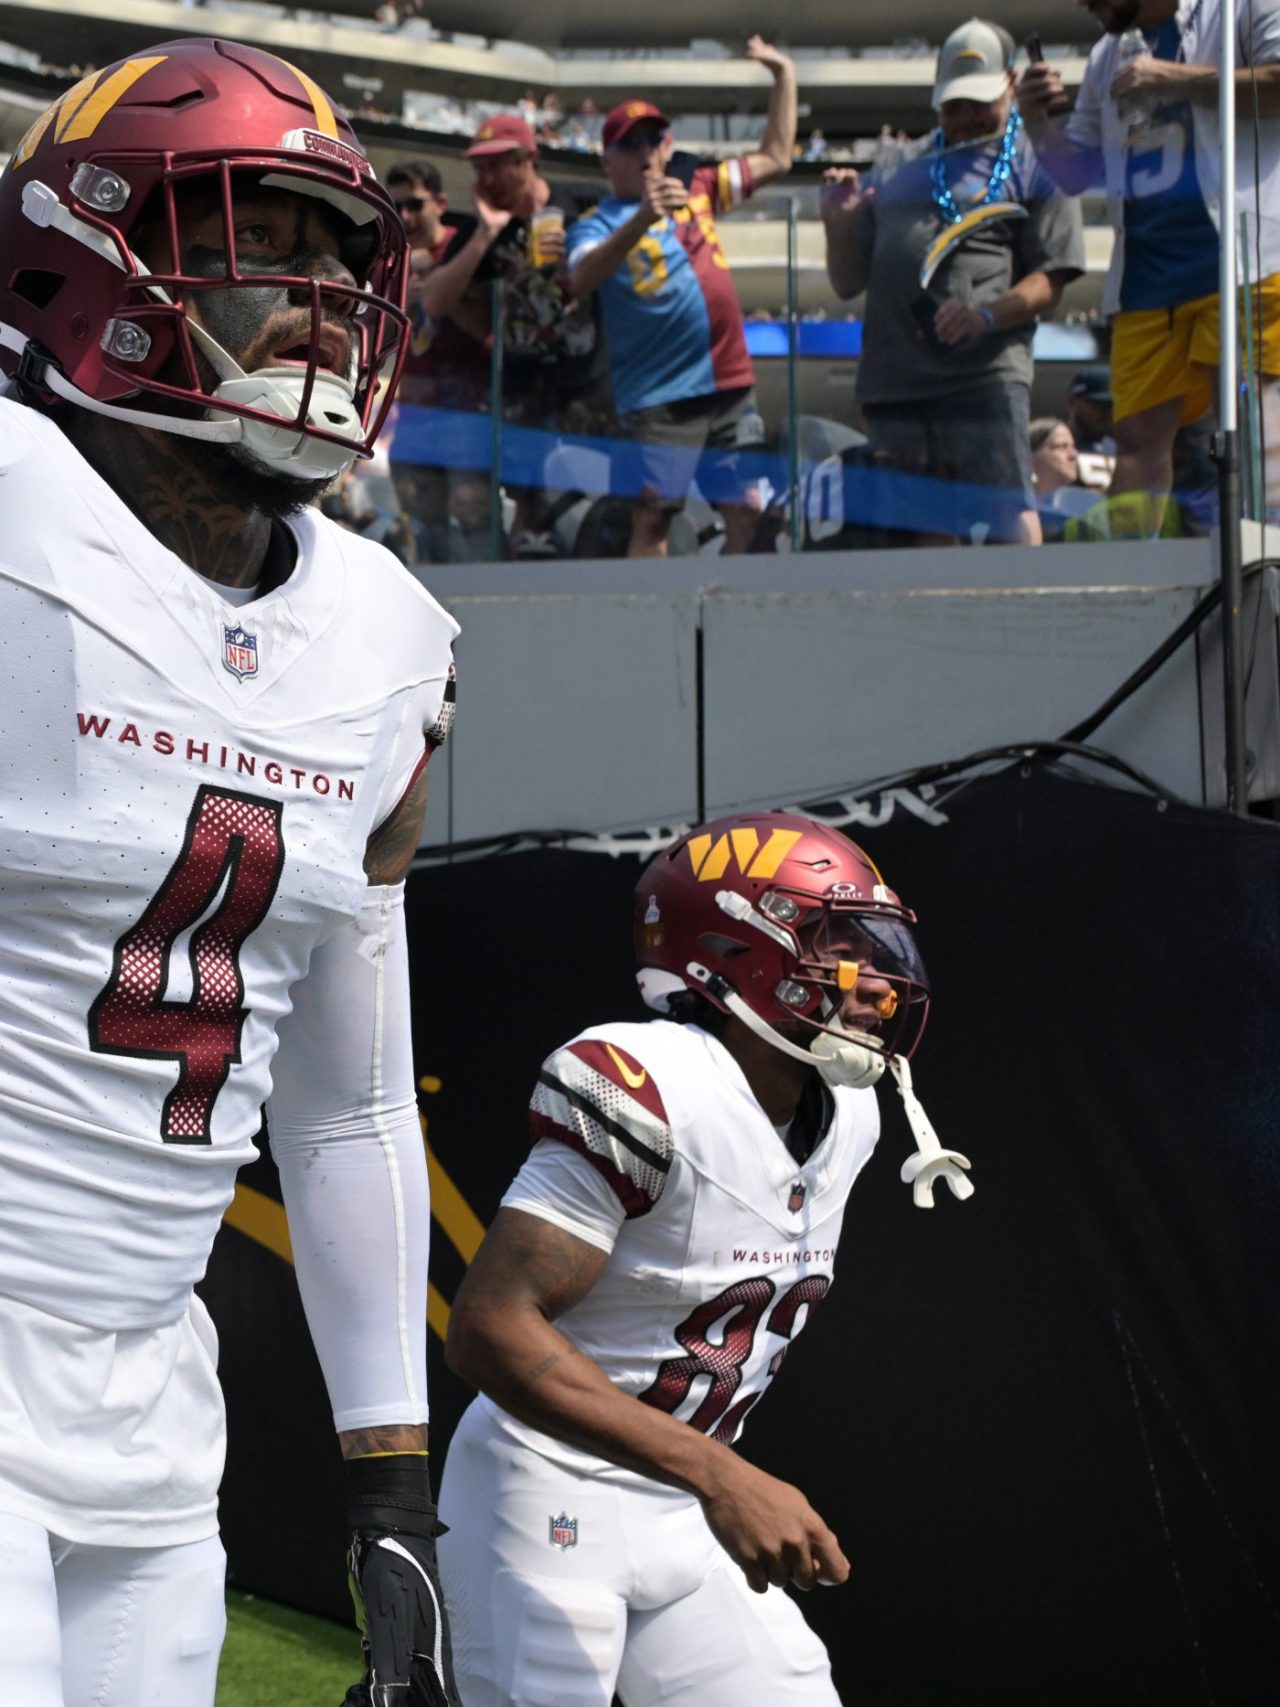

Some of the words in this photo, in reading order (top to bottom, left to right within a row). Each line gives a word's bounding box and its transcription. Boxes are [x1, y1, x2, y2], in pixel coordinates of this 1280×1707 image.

[226, 643, 256, 671] NFL
[76, 712, 355, 801] WASHINGTON
[87, 783, 285, 1145] 4
